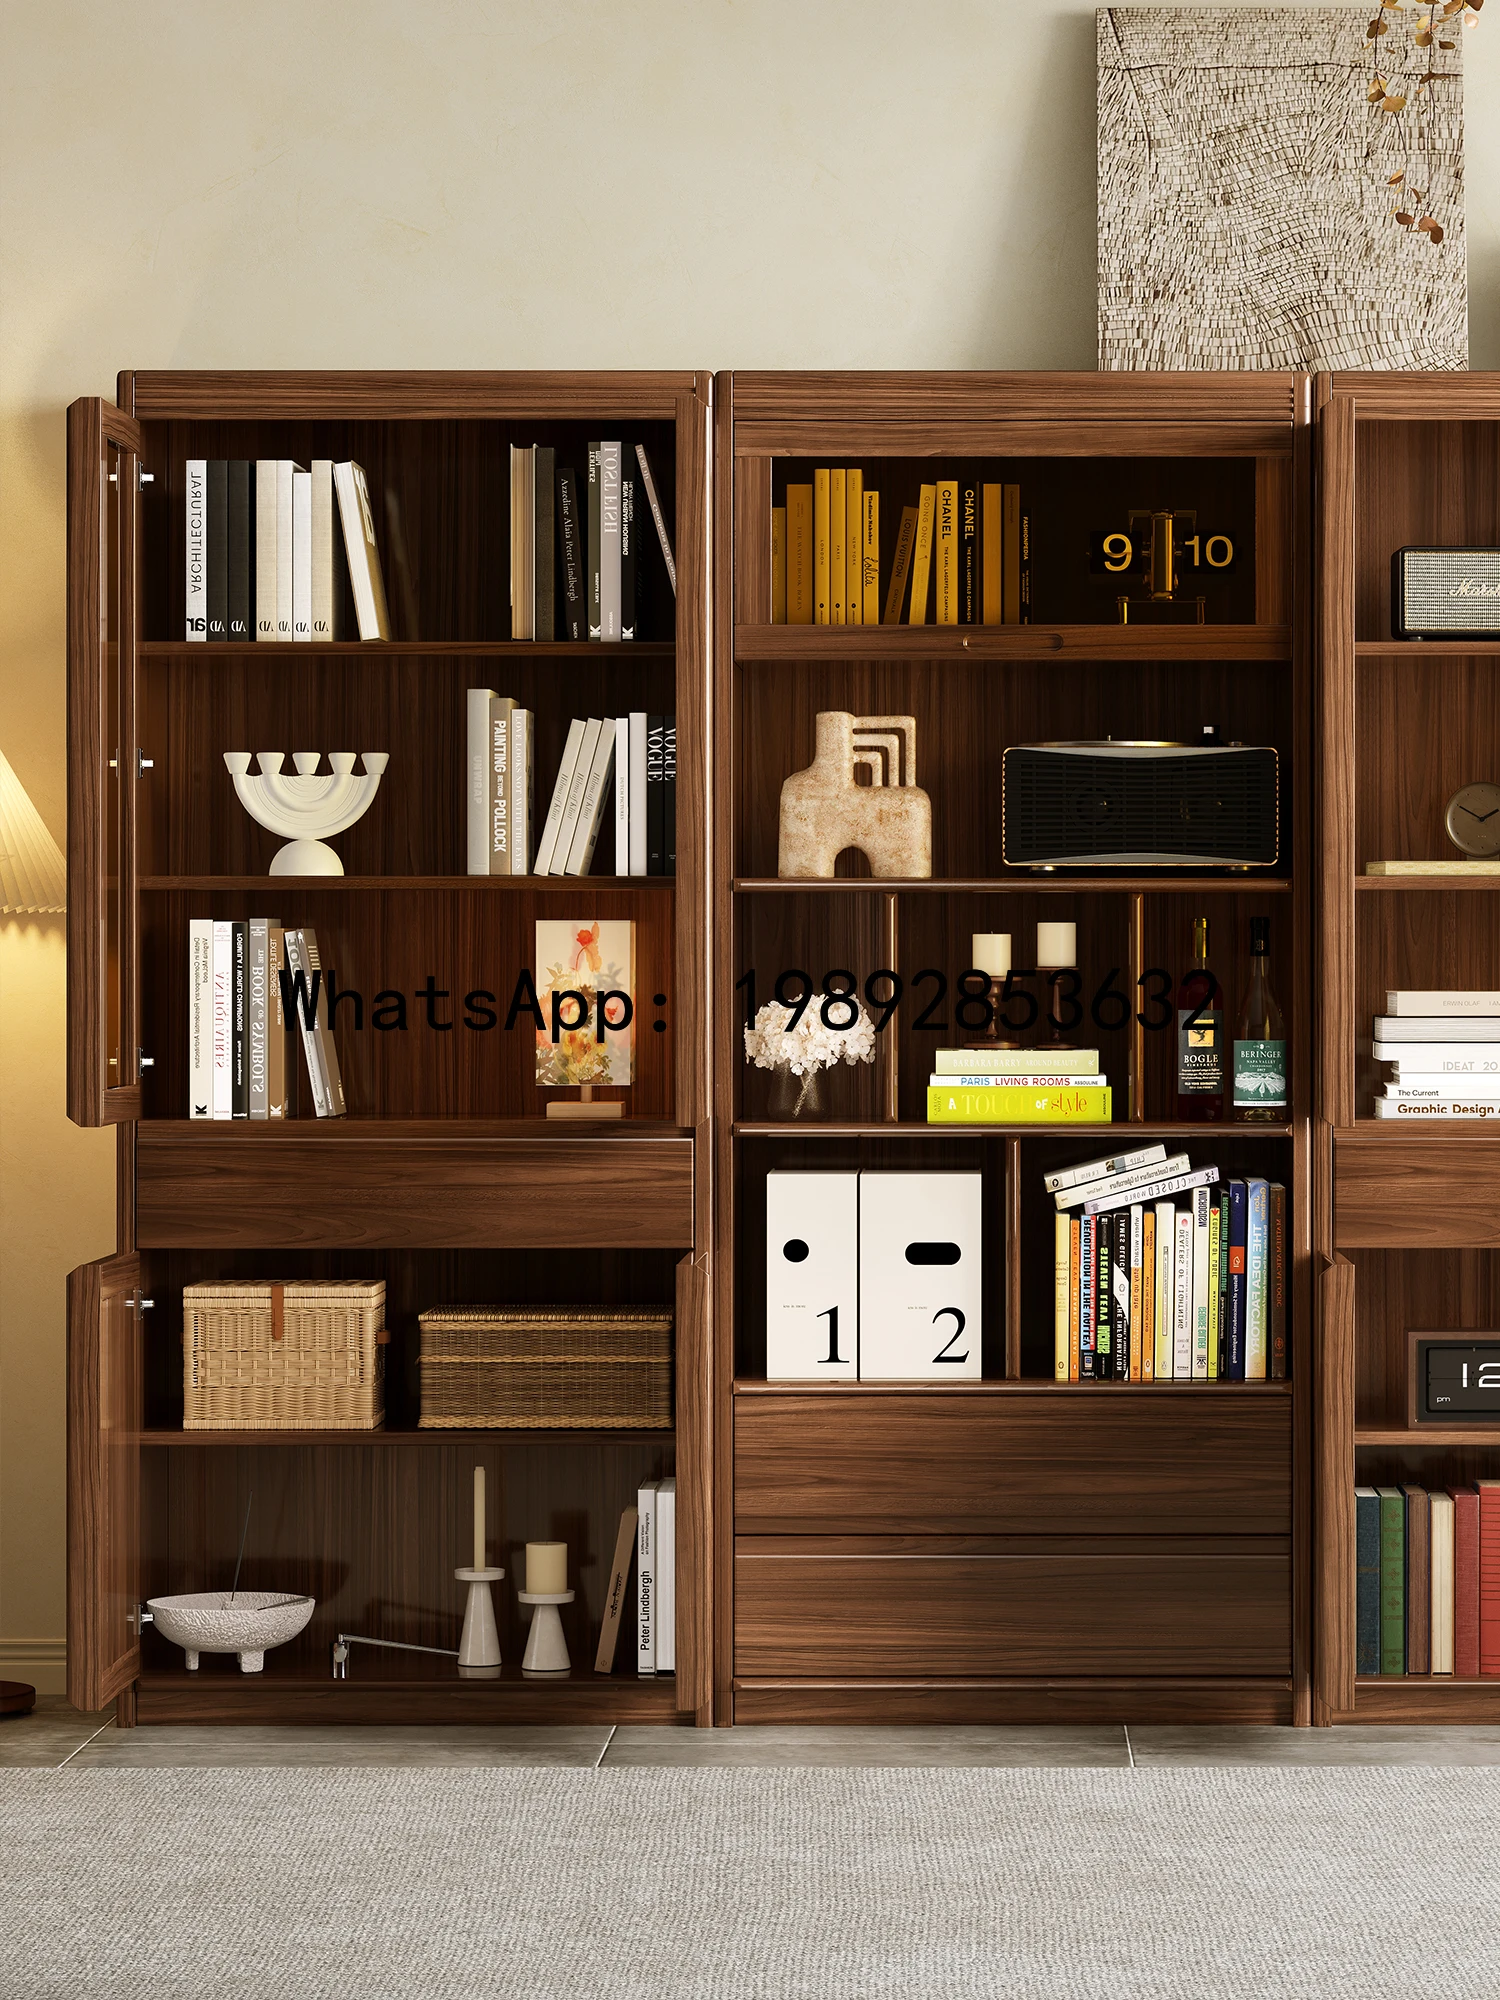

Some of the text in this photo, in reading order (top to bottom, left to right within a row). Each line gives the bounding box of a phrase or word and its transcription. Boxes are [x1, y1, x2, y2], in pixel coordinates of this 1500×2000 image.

[942, 490, 952, 540] CHANEL
[964, 490, 974, 540] CHANEL
[1102, 533, 1234, 572] 9 10
[494, 720, 506, 772] PAINTING
[648, 726, 663, 782] VOGUE
[494, 800, 507, 852] POLLOCK
[1184, 1054, 1218, 1064] BOGLE
[1240, 1050, 1282, 1058] BERINGER
[1442, 1062, 1475, 1071] IDEAT
[960, 1078, 990, 1086] PARIS
[995, 1078, 1028, 1086] LIVING
[1032, 1078, 1070, 1086] ROOMS
[948, 1098, 956, 1110] A
[1452, 1104, 1494, 1117] Design
[816, 1305, 850, 1363] 1
[932, 1306, 970, 1363] 2
[1462, 1362, 1500, 1388] 12
[1436, 1396, 1451, 1404] pm
[640, 1570, 652, 1650] Peter Lindbergh
